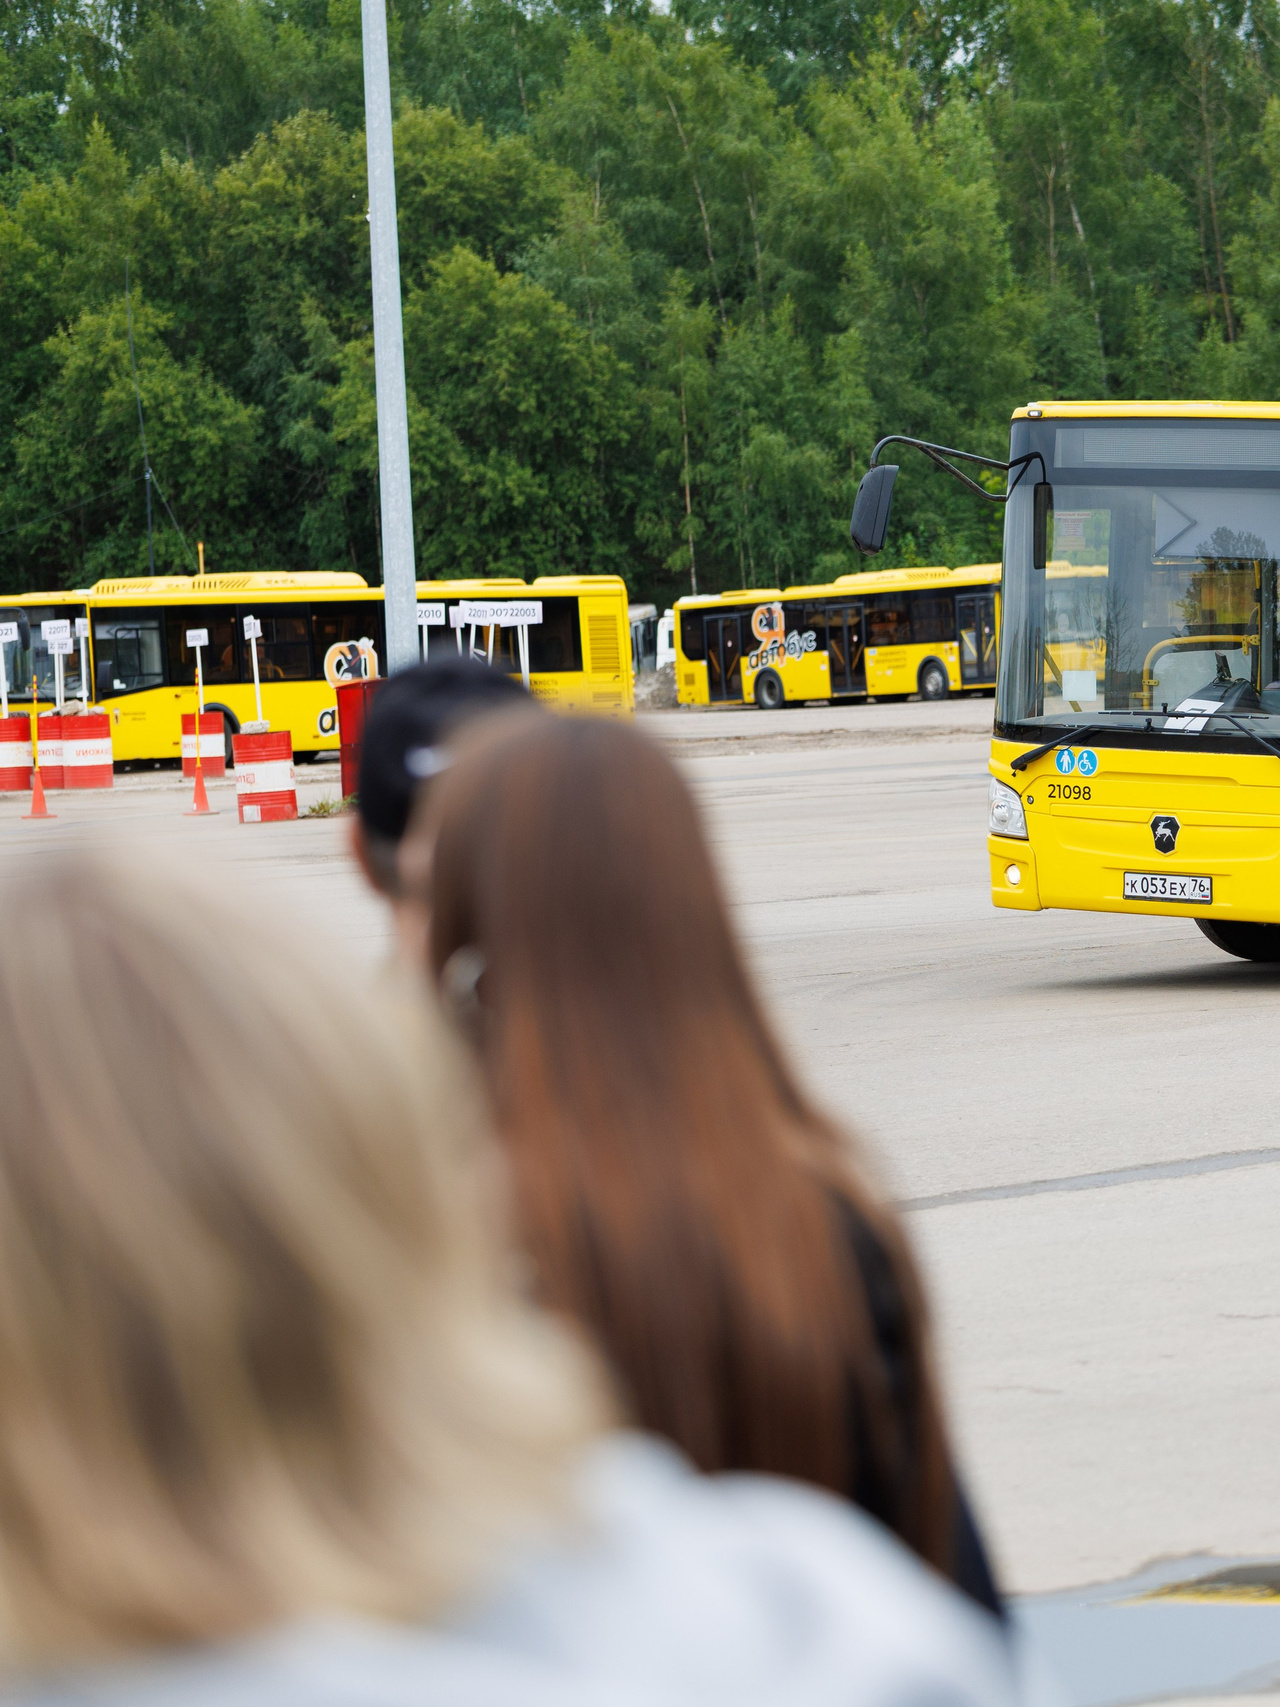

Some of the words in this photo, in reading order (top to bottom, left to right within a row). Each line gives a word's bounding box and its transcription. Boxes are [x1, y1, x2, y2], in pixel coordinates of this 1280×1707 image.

[418, 609, 442, 618] 2010
[490, 608, 508, 617] 007
[509, 608, 536, 617] 22003
[1047, 783, 1091, 801] 21098
